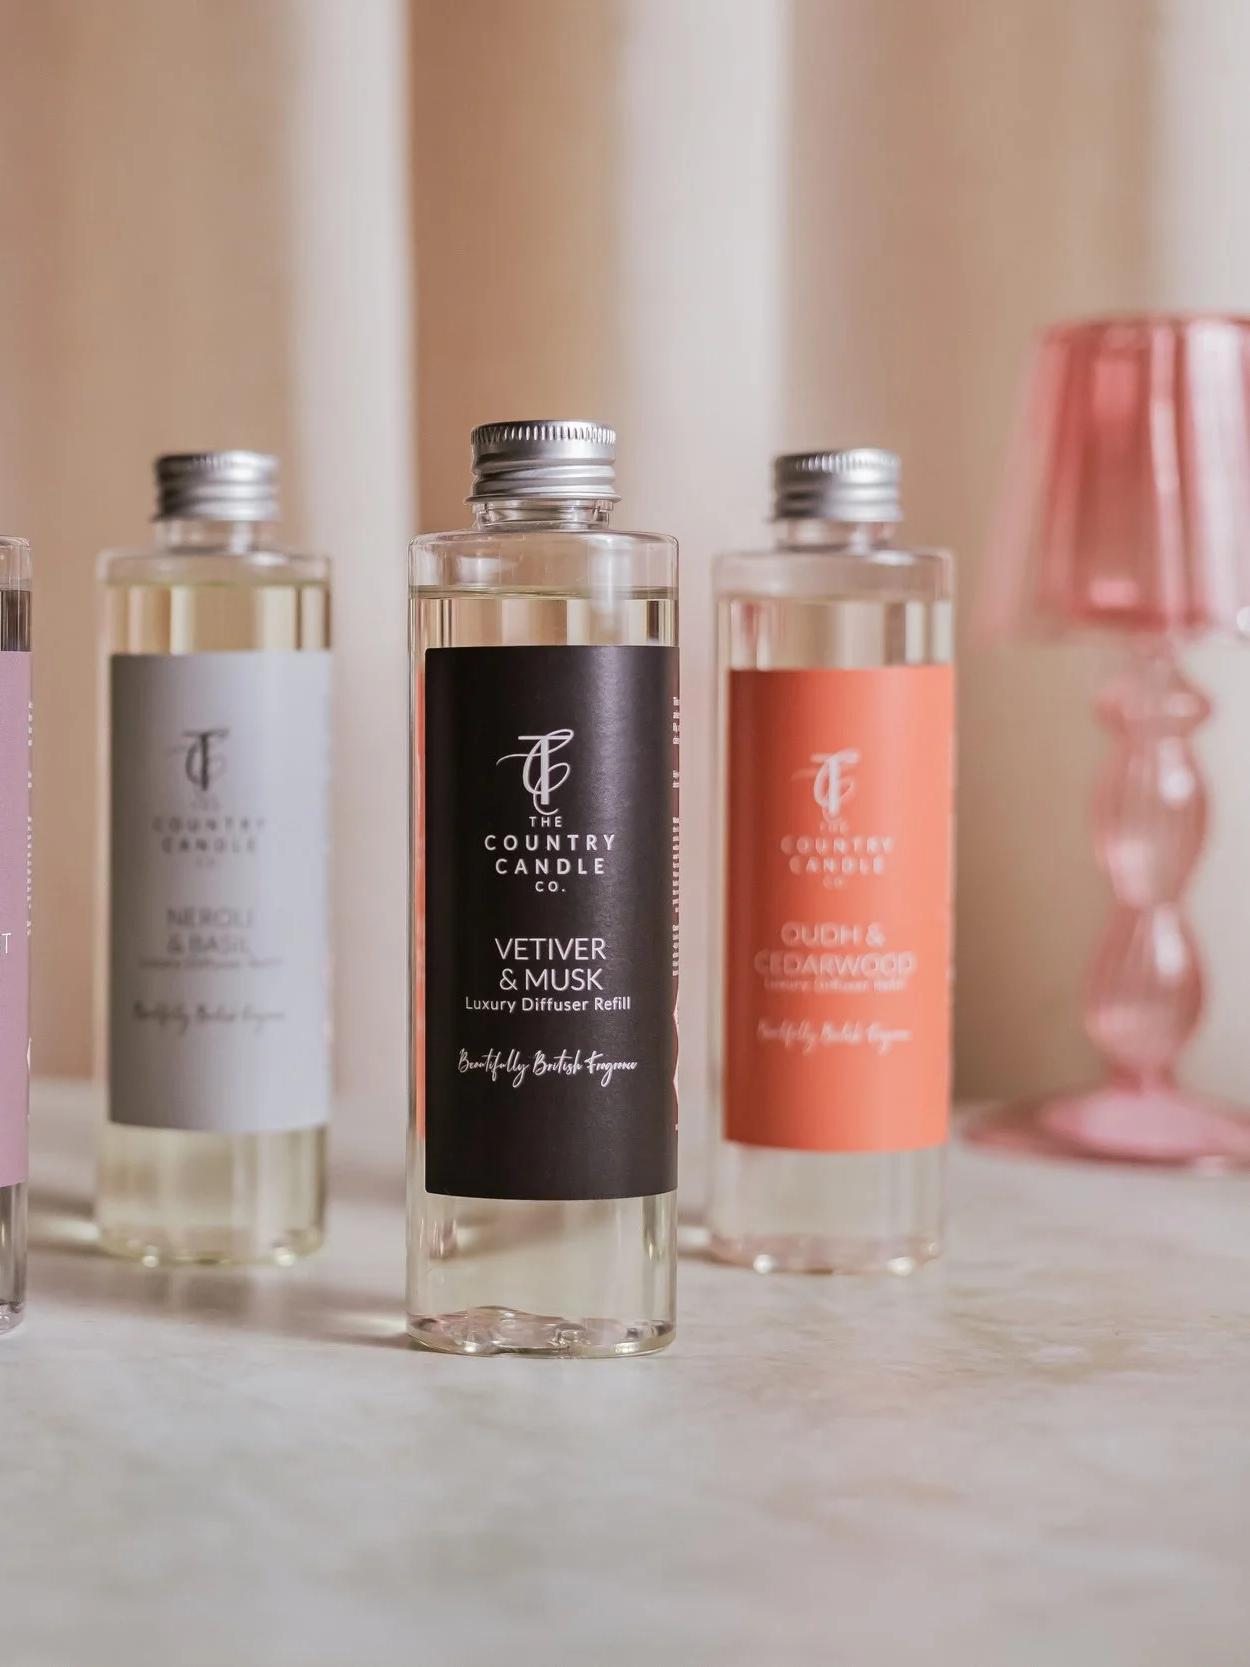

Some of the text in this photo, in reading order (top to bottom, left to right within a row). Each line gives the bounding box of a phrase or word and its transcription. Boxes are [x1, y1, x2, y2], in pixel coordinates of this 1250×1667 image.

[528, 816, 563, 828] THE
[484, 834, 615, 851] COUNTRY
[780, 835, 894, 855] COUNTRY
[495, 858, 605, 875] CANDLE
[789, 856, 886, 876] CANDLE
[535, 881, 566, 892] CO.
[781, 921, 886, 948] OUDH &
[494, 937, 607, 960] VETIVER
[753, 950, 918, 978] CEDARWOOD
[499, 968, 604, 991] & MUSK
[465, 996, 631, 1013] Luxury Diffuser Refill
[457, 1048, 638, 1088] Beautifully British Fragrance
